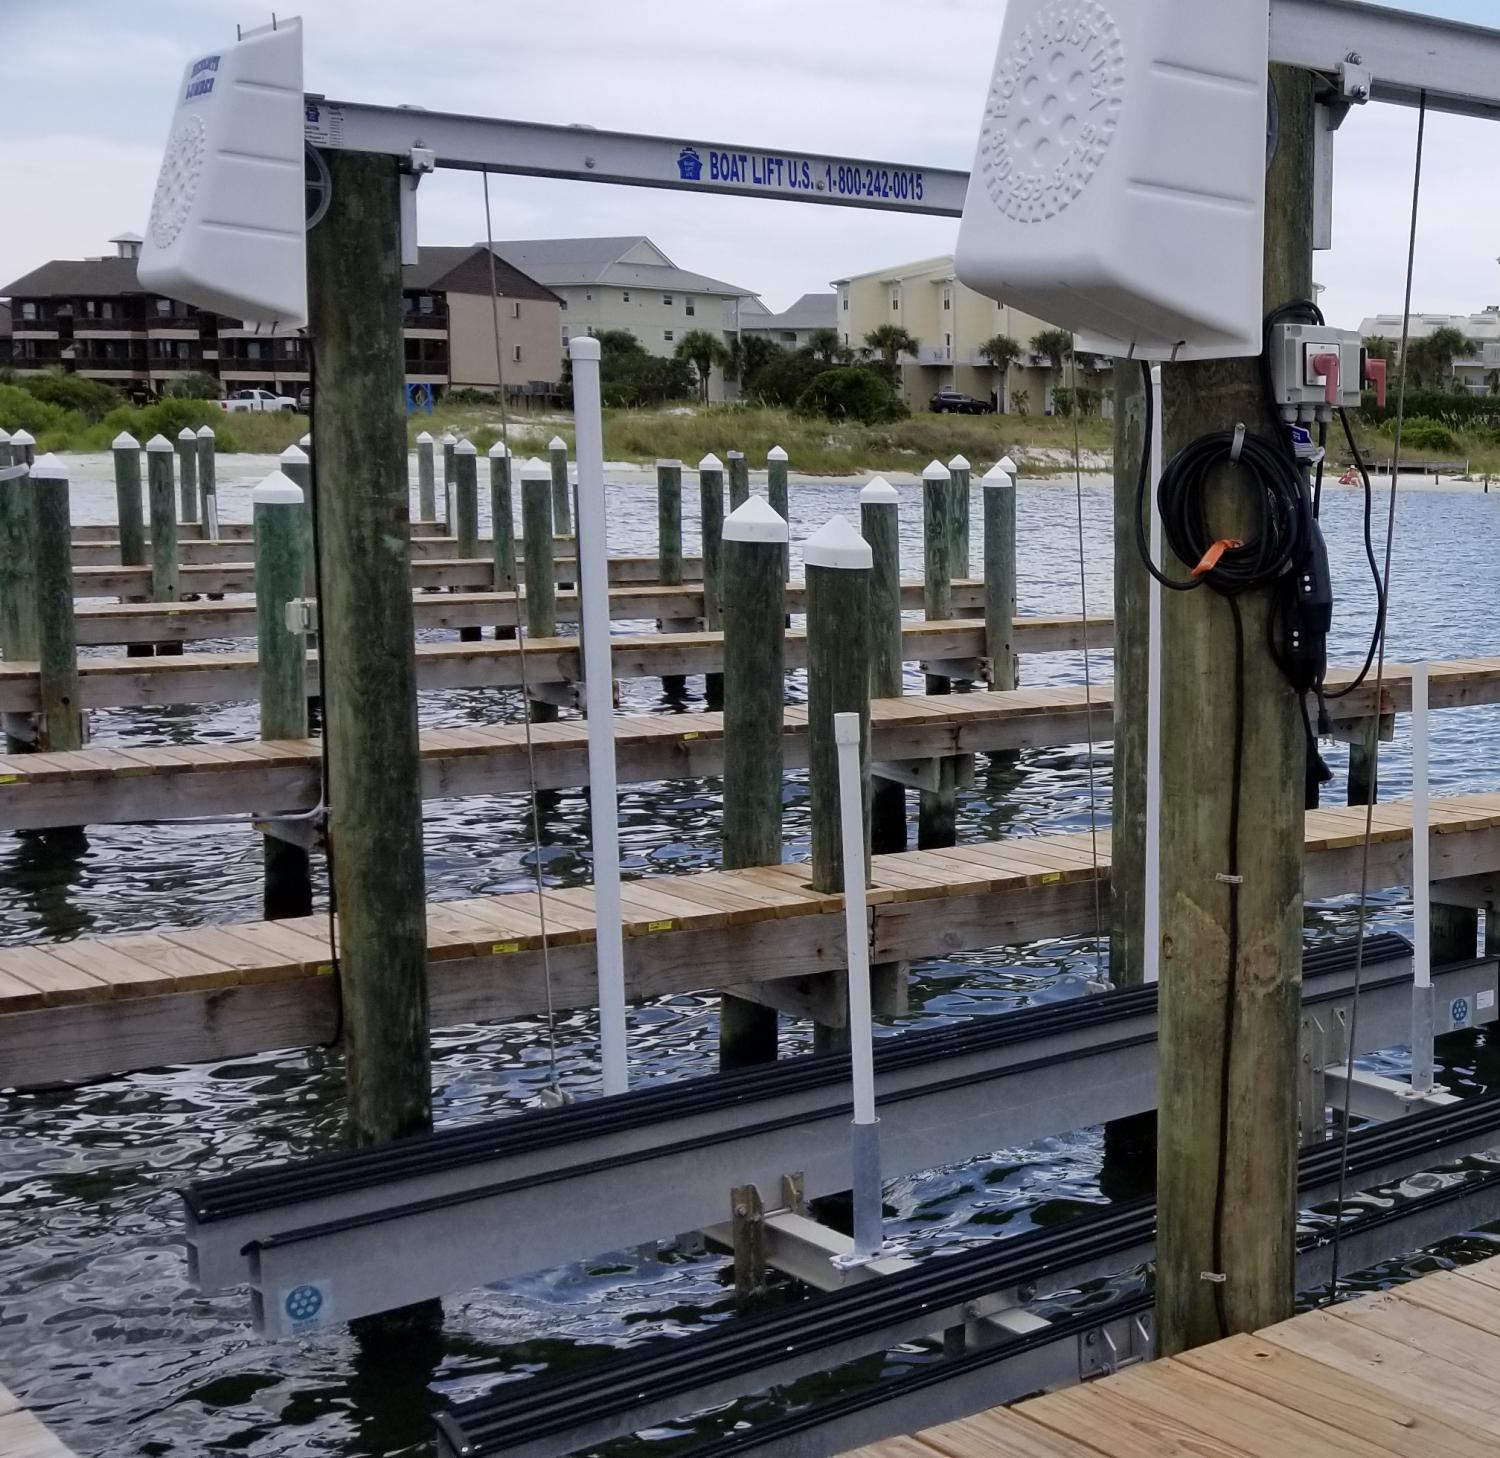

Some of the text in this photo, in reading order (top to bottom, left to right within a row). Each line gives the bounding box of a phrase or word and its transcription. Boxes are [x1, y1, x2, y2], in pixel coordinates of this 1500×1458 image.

[709, 152, 747, 182] BOAT
[753, 157, 783, 186] LIFT
[788, 161, 814, 189] U.S.
[826, 165, 923, 201] 1-800-242-0015
